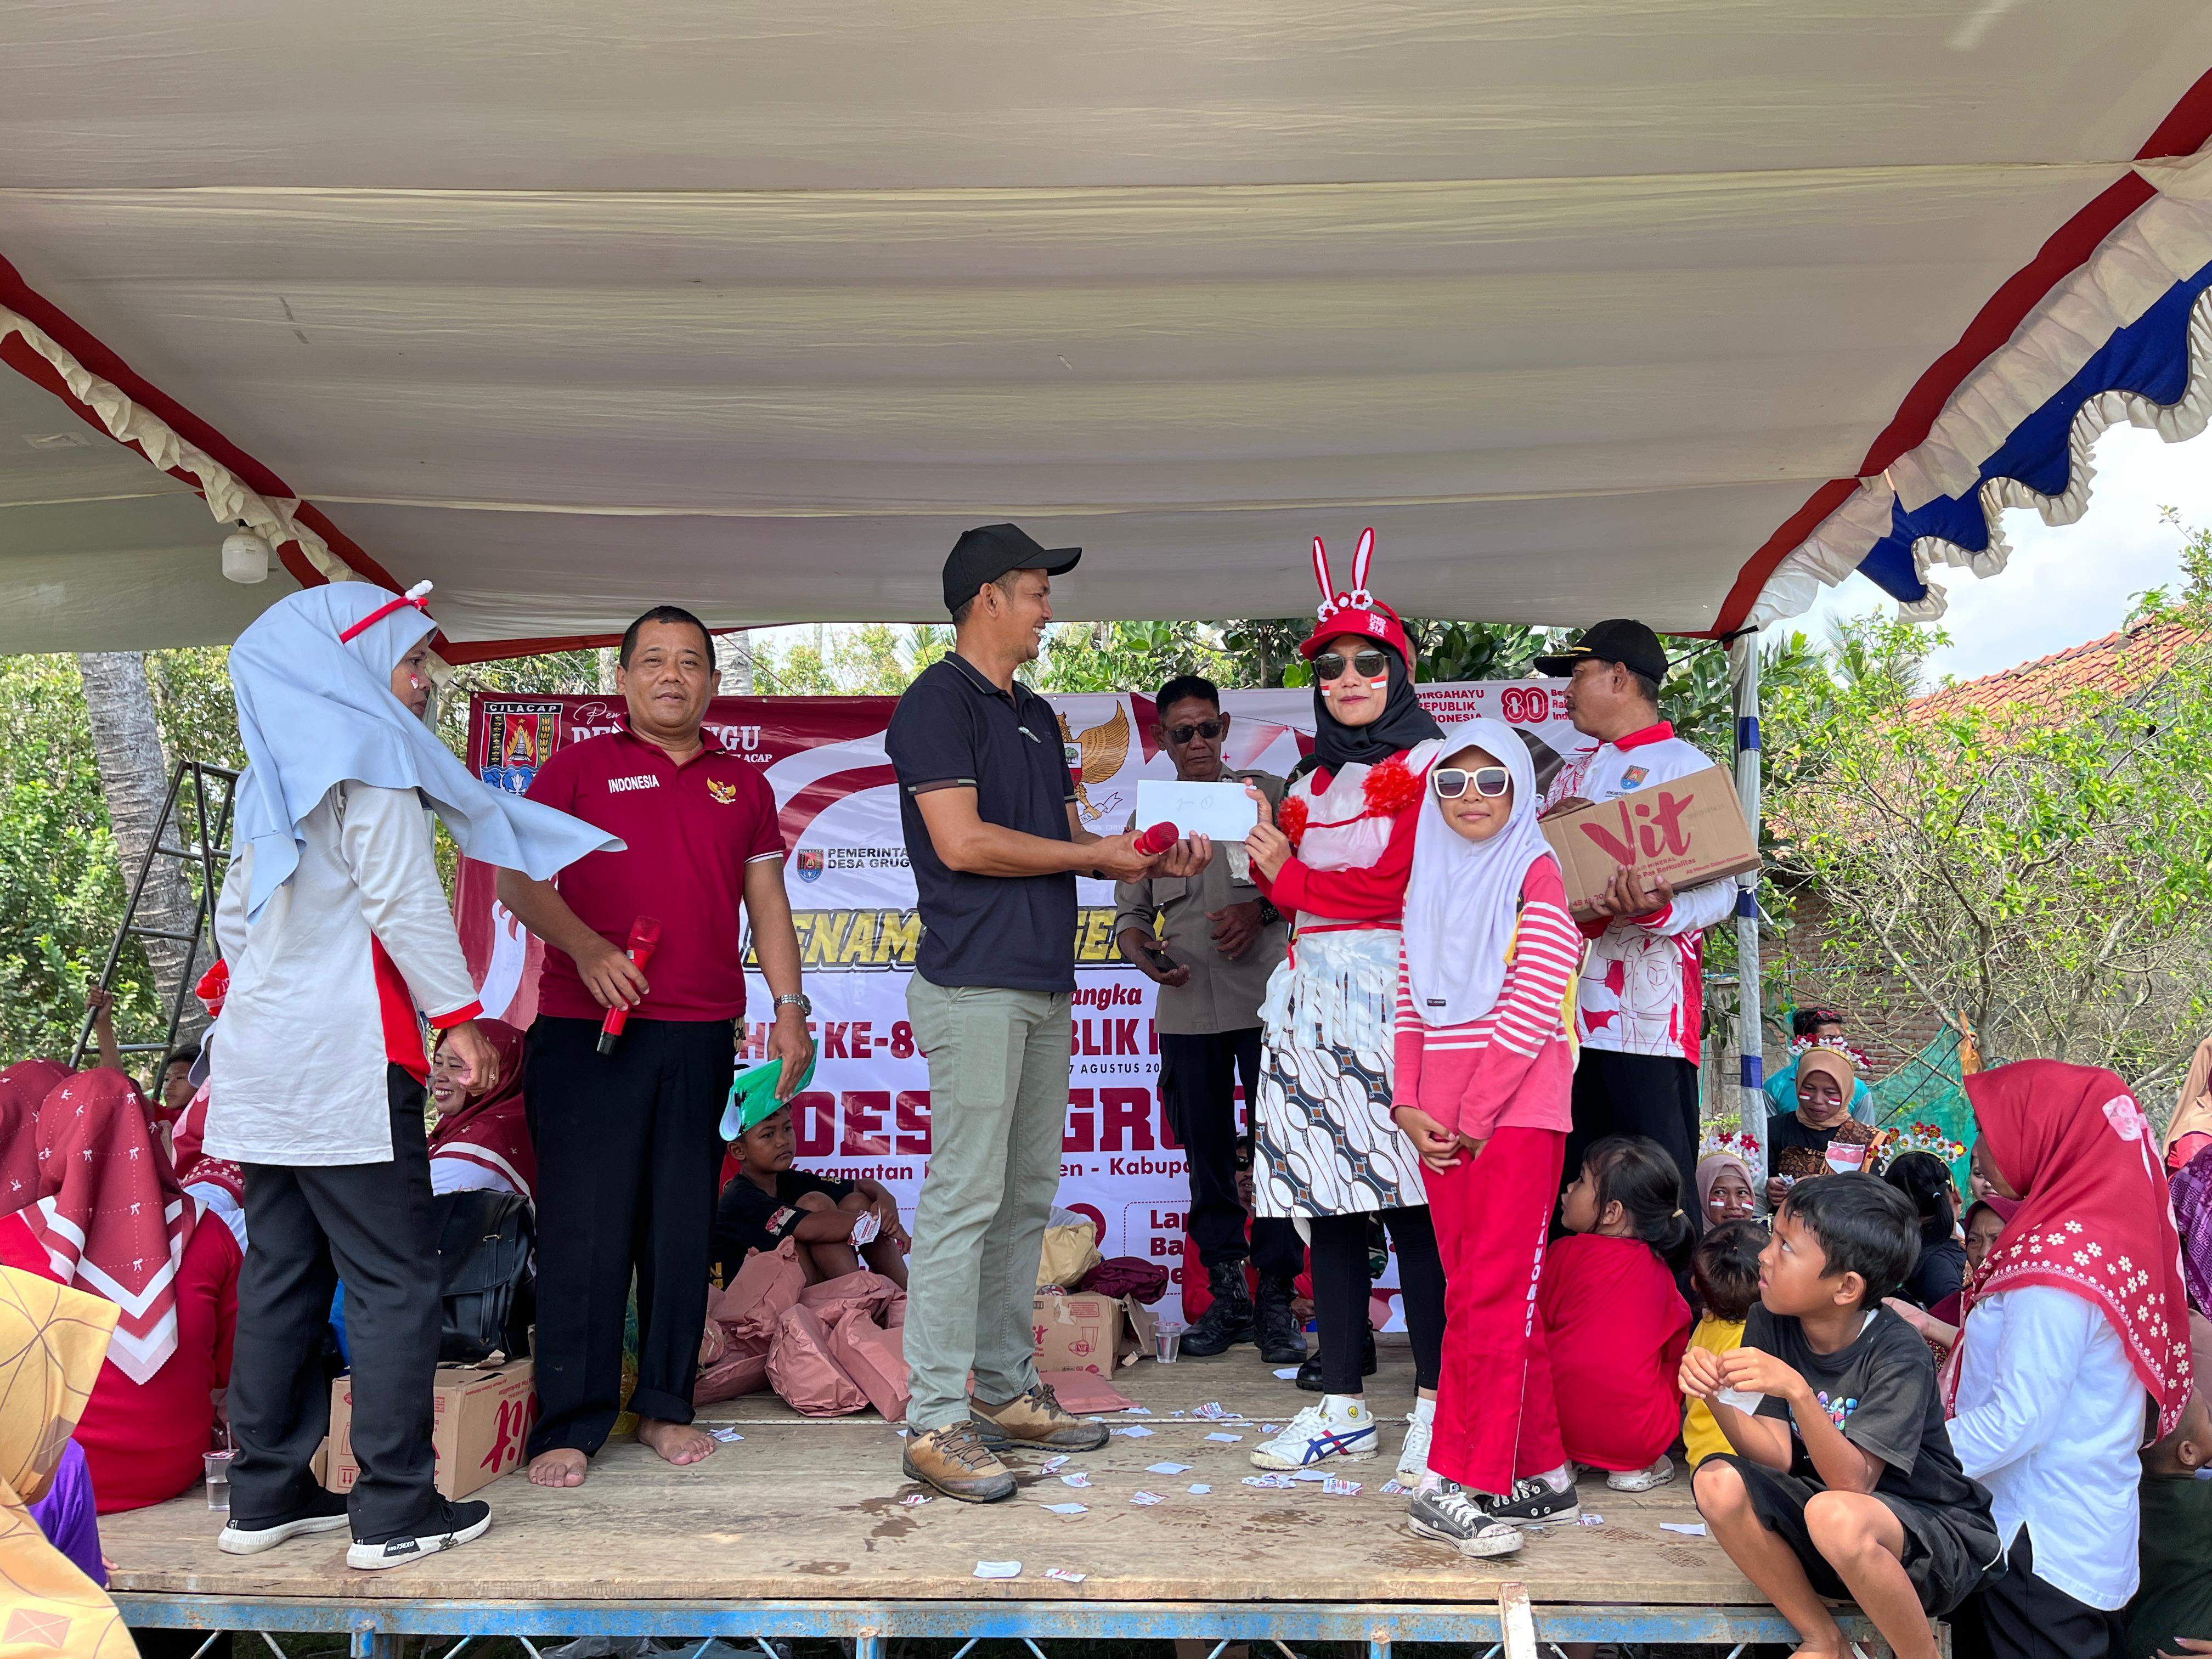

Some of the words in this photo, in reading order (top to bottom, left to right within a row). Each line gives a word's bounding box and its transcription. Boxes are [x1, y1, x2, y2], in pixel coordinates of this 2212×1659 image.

[489, 704, 557, 713] CILACAP
[1501, 687, 1549, 724] 80
[608, 774, 660, 793] INDONESIA
[1081, 814, 1092, 822] IKA
[1579, 792, 1694, 866] Vit
[828, 848, 909, 858] PEMERINTA
[828, 859, 865, 869] DESA
[869, 858, 910, 868] GRUG
[1647, 857, 1676, 868] MINERAL
[1656, 858, 1696, 874] Berkualitas
[1070, 983, 1142, 1011] angka
[825, 1020, 929, 1059] KE-8
[1081, 1063, 1139, 1074] AGUSTUS
[1146, 1063, 1160, 1073] 20
[790, 1090, 932, 1157] DES
[480, 1392, 536, 1474] Vit
